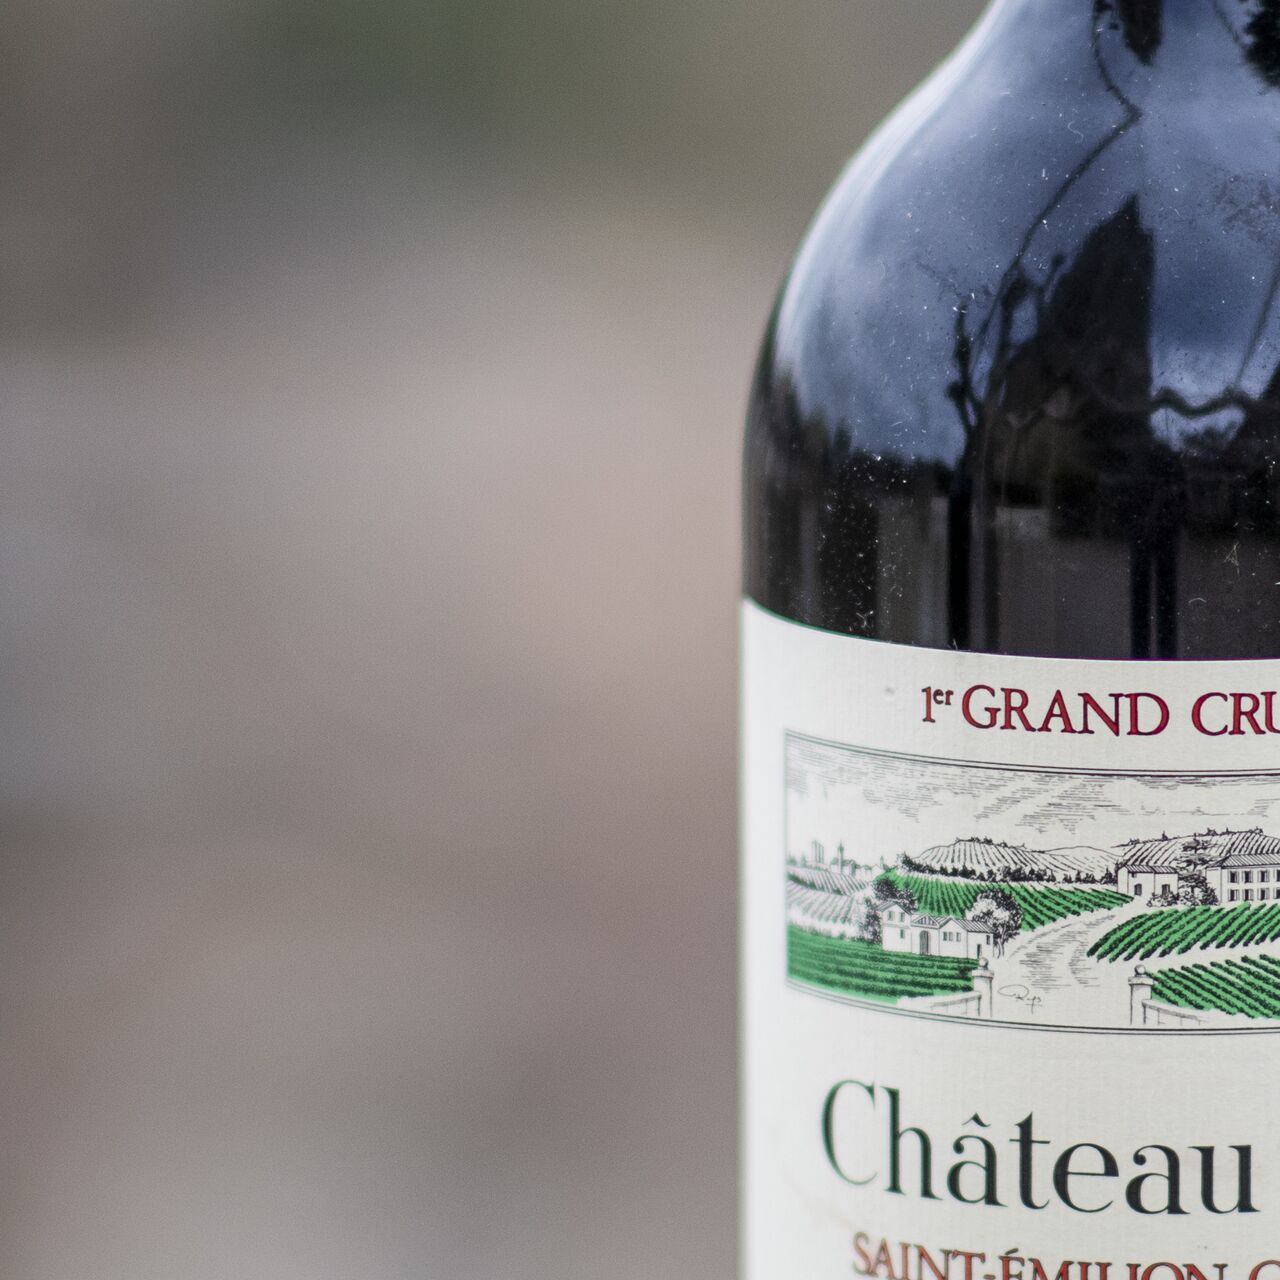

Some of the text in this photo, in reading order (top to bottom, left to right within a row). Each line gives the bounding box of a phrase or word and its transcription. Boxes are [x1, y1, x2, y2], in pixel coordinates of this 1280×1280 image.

[921, 685, 954, 724] 1er
[962, 684, 1170, 738] GRAND
[820, 1079, 1261, 1215] Château
